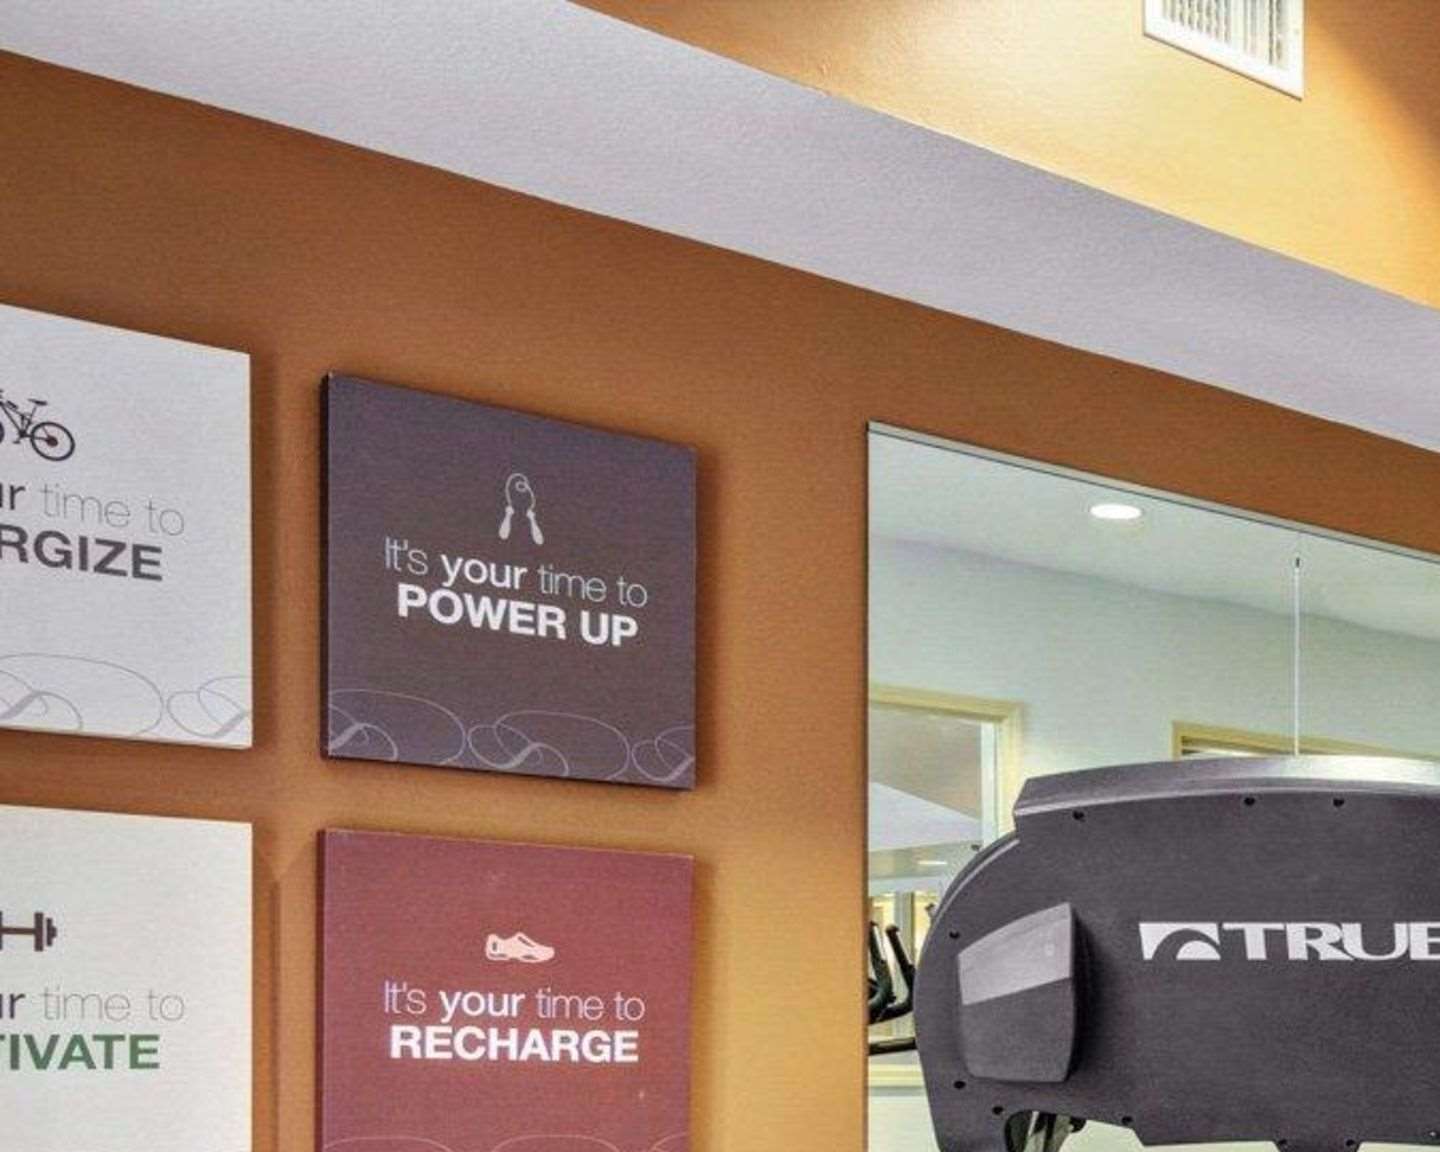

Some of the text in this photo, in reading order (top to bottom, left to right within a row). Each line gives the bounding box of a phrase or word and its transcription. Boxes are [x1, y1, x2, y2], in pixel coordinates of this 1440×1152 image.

[39, 483, 131, 528] time
[144, 498, 185, 536] to
[384, 536, 648, 608] It's your time to
[398, 583, 639, 647] POWER UP
[39, 984, 131, 1022] time
[145, 989, 185, 1022] to
[384, 980, 647, 1023] It's your time to
[0, 1033, 161, 1071] IVATE
[390, 1025, 640, 1063] RECHARGE
